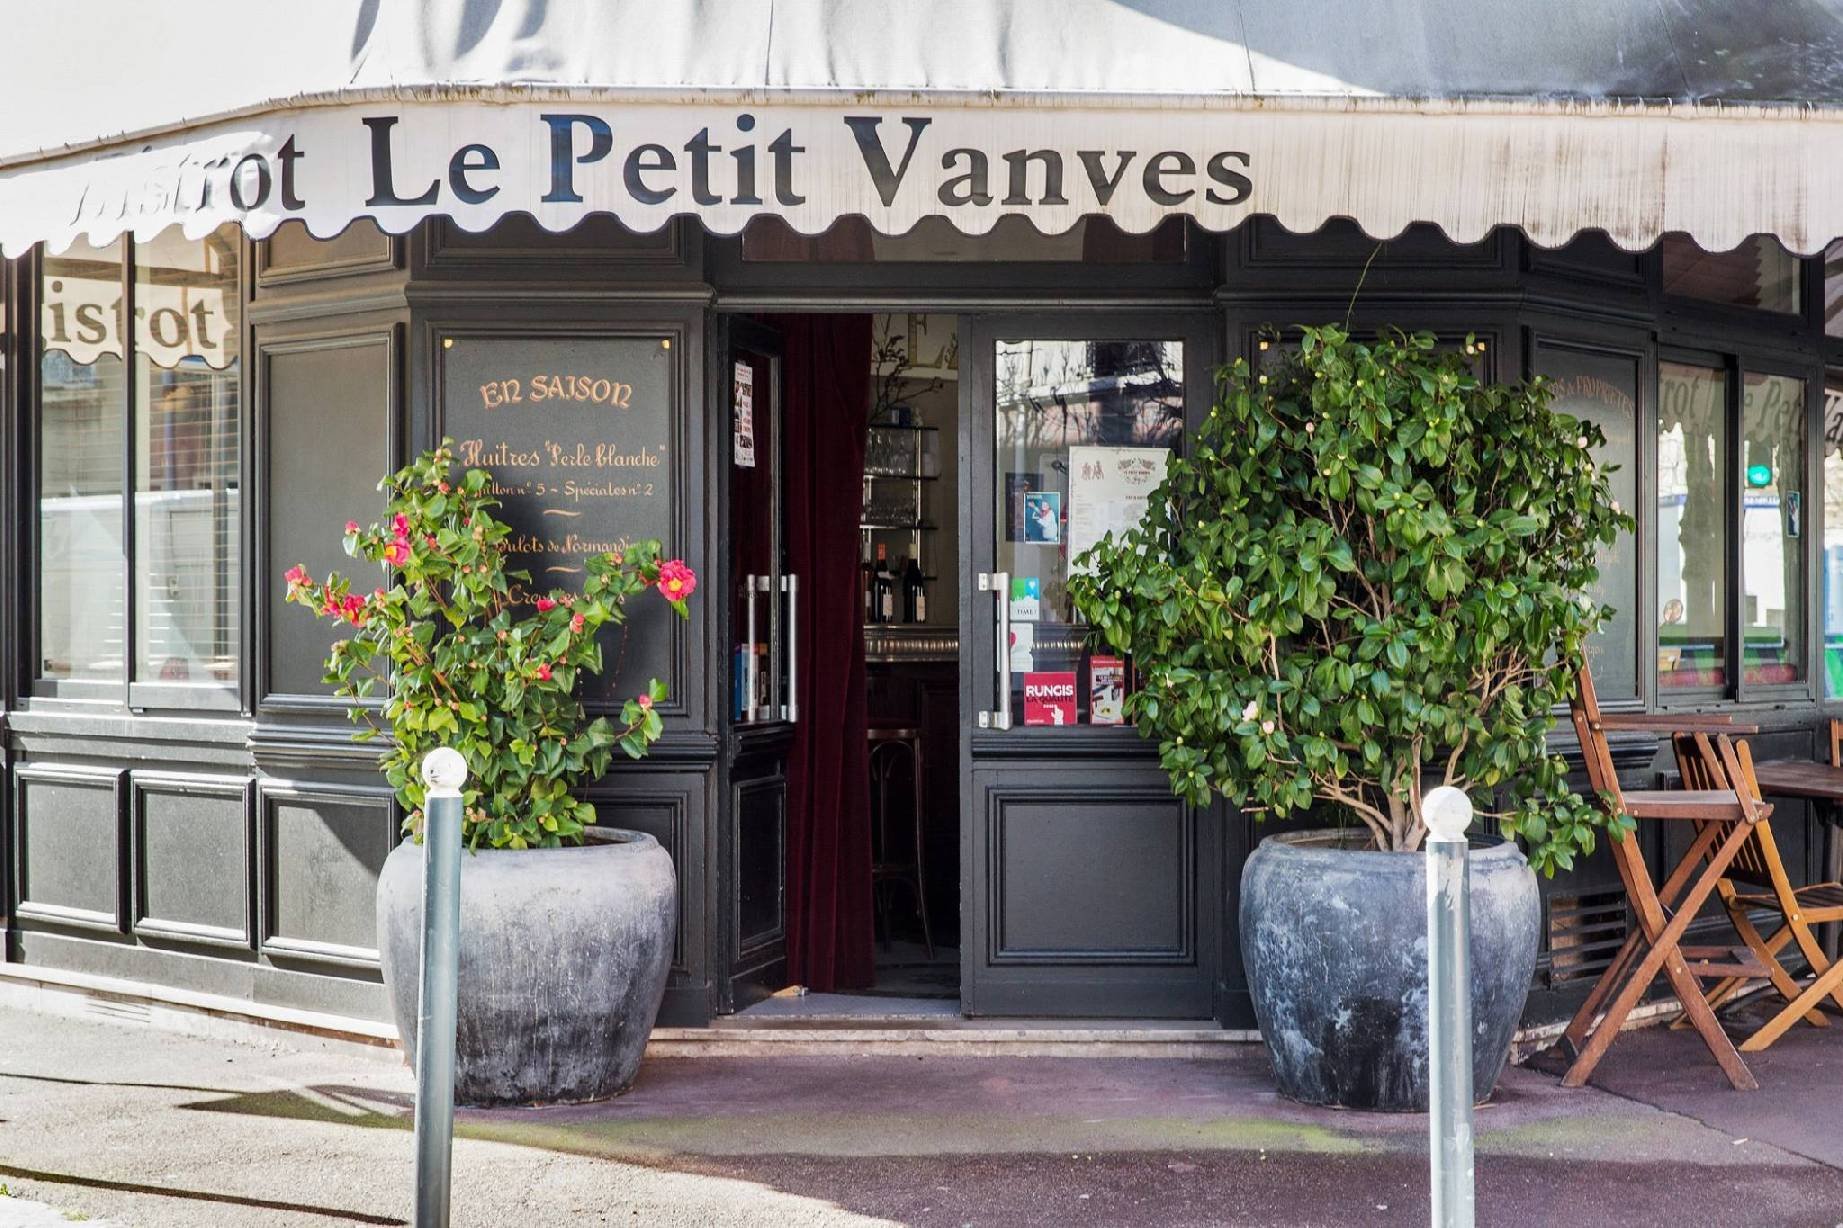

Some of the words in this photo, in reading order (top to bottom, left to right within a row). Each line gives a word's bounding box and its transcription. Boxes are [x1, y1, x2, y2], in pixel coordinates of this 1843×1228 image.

[361, 115, 501, 208] Le
[540, 113, 806, 206] Petit
[843, 115, 1254, 207] Vanves
[529, 375, 633, 410] SAISON
[1026, 685, 1074, 697] RUNGIS
